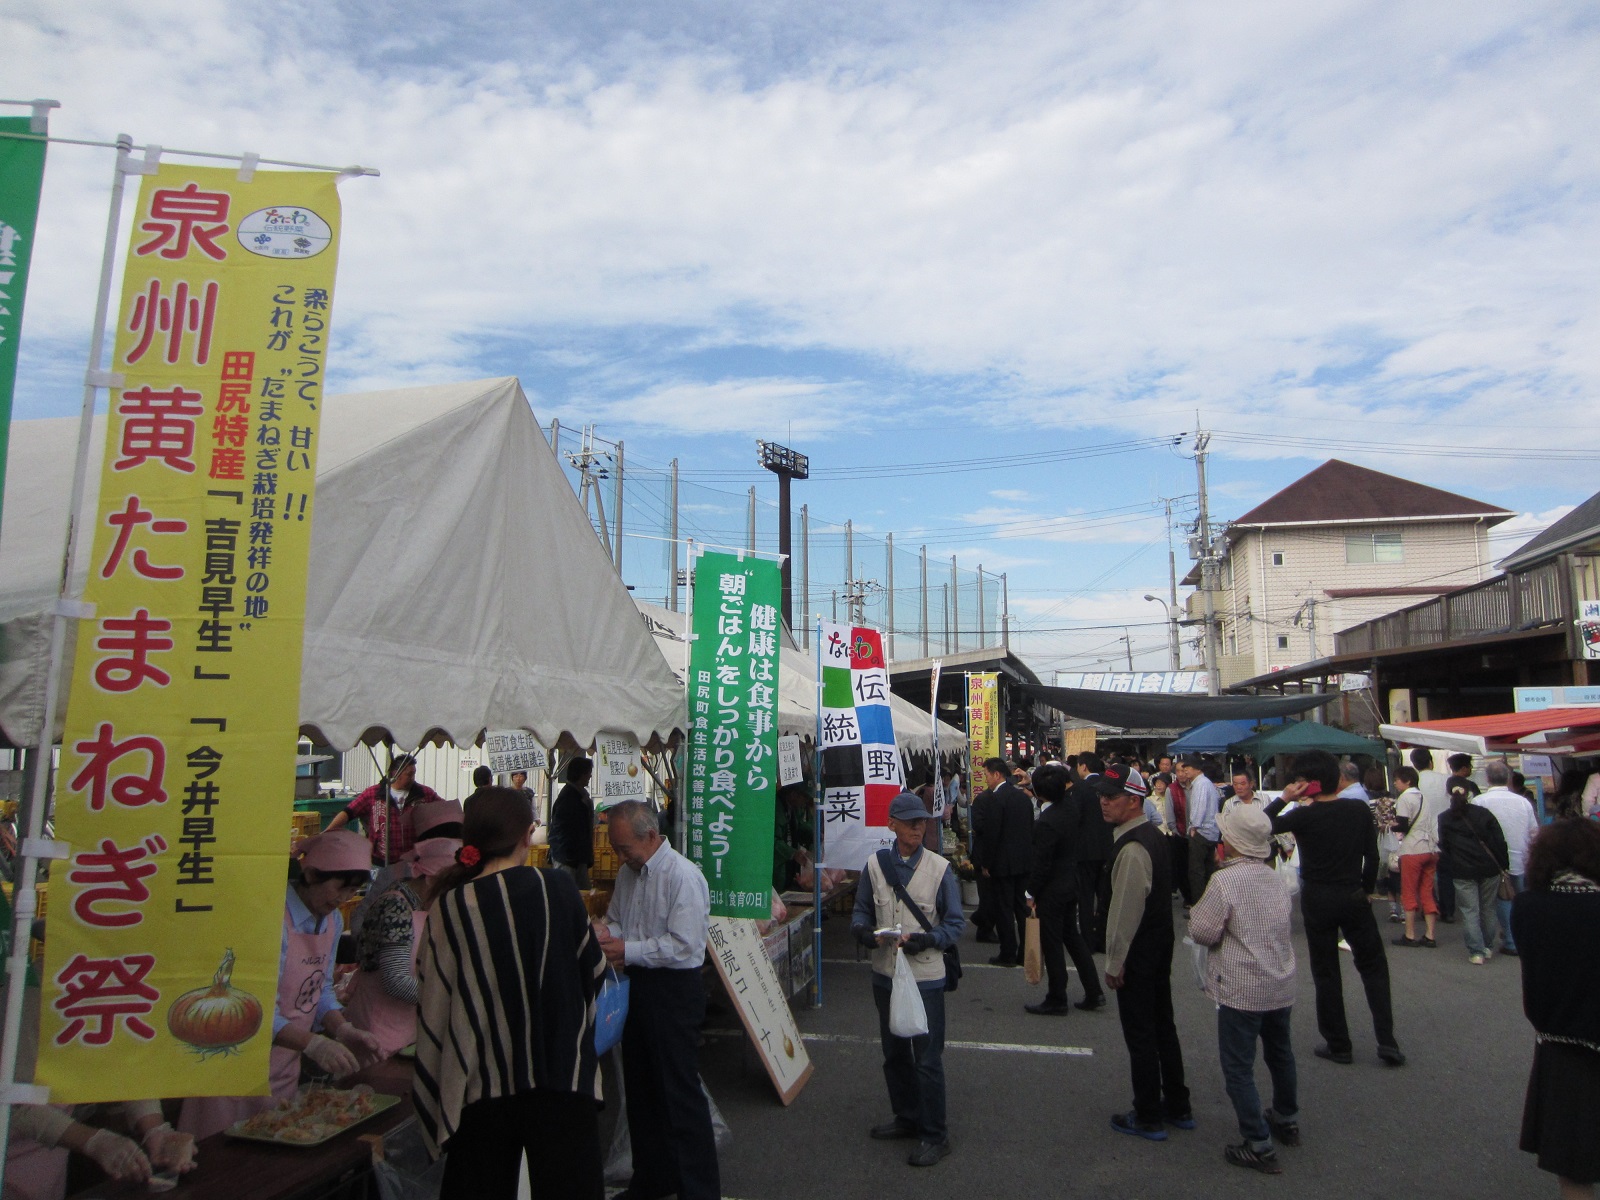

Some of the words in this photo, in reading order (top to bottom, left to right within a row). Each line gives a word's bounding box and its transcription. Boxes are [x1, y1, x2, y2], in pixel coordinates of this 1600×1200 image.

[55, 183, 231, 1046] 泉州黄たまねぎ祭
[745, 603, 777, 790] 健康は食事から
[707, 923, 786, 1078] 販売コーナー
